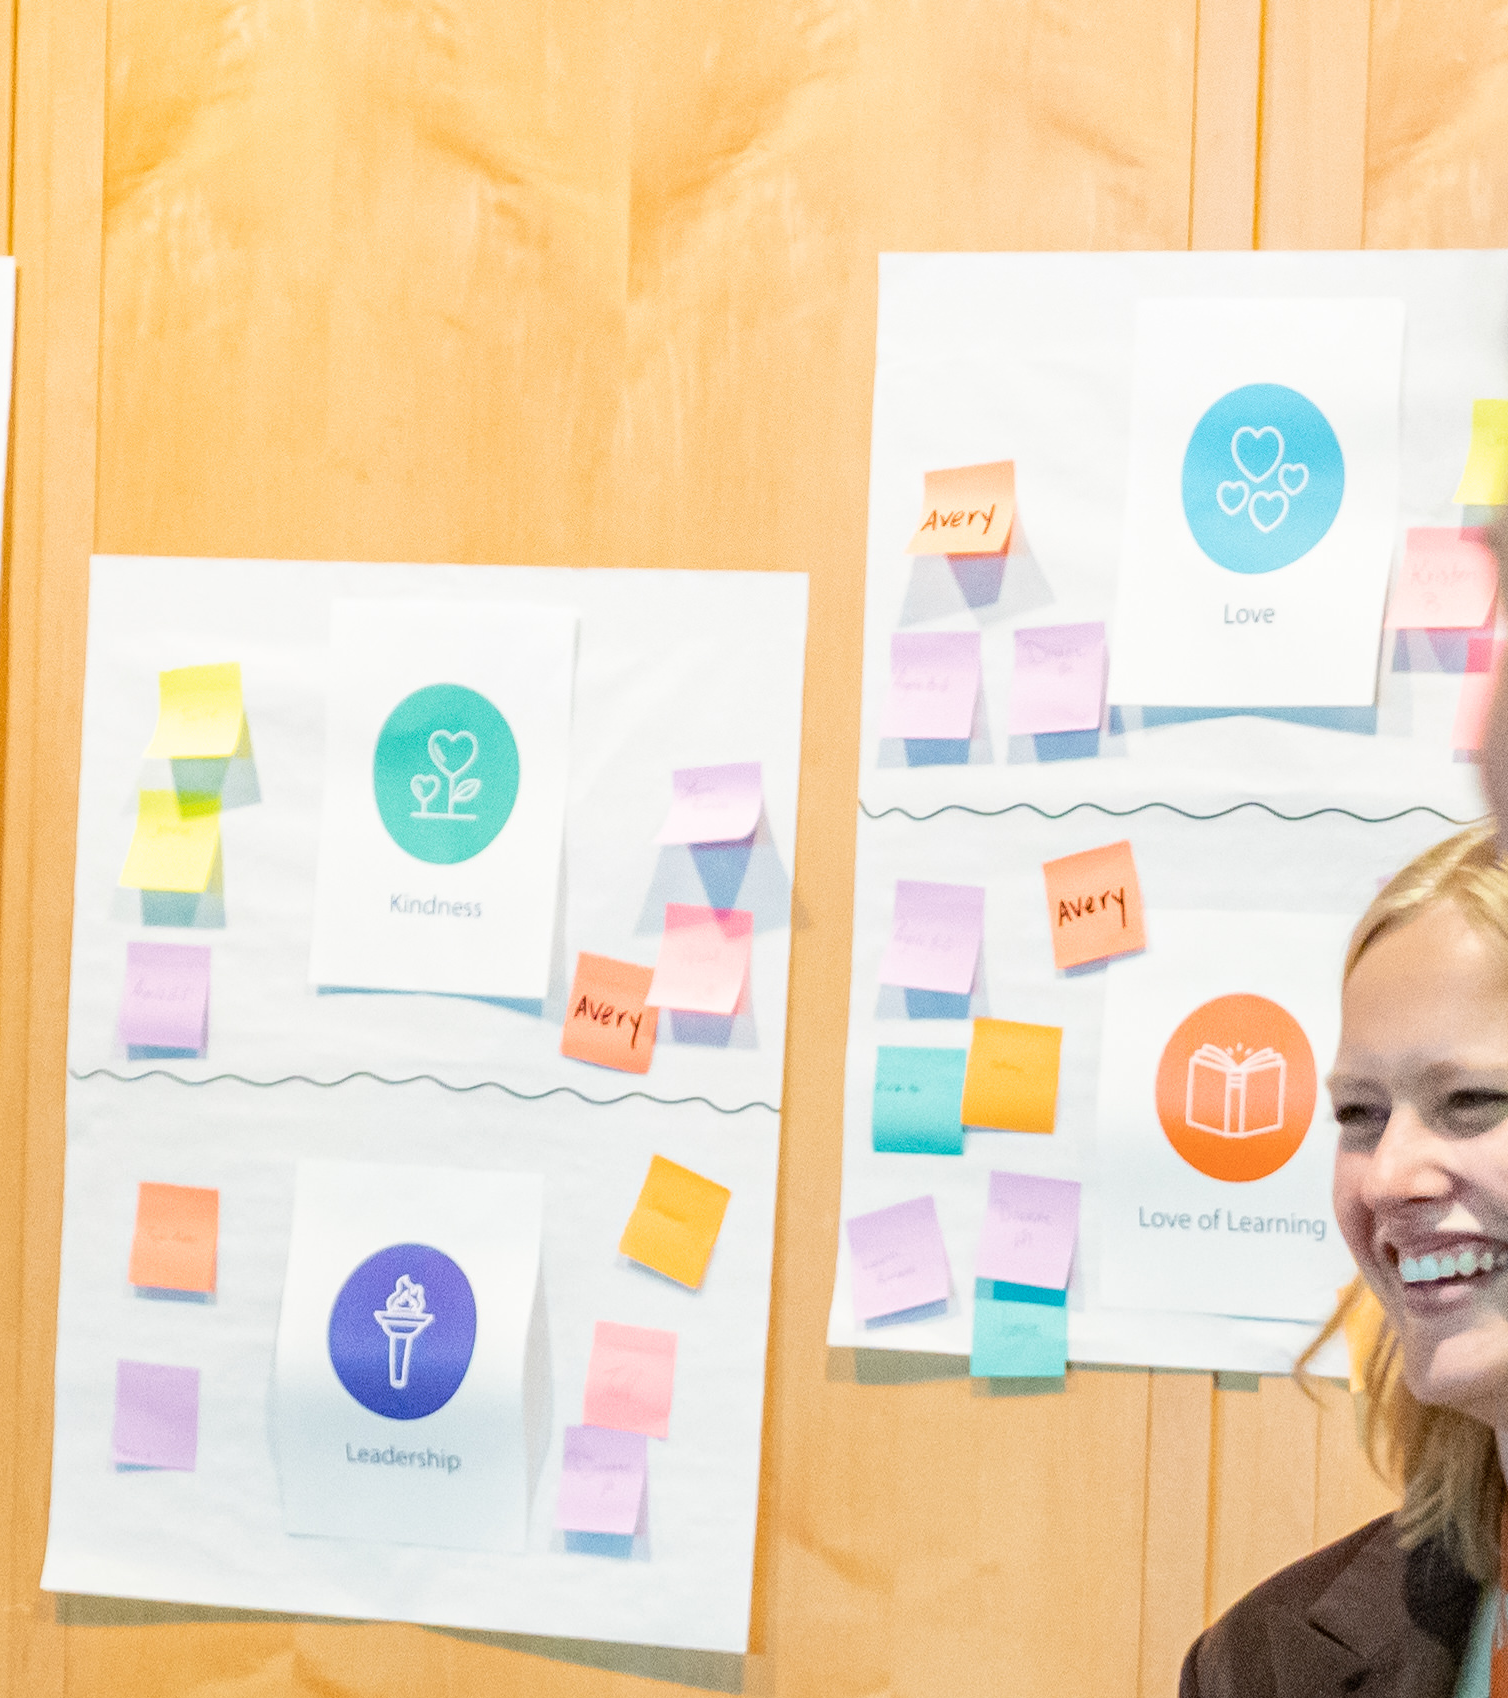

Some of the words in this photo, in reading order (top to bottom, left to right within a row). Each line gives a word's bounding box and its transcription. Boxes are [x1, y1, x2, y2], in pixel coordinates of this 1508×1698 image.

[920, 502, 997, 535] Avery
[1222, 603, 1277, 626] Love
[388, 892, 484, 919] Kindness
[1057, 885, 1128, 929] Avery
[573, 993, 644, 1050] Avery
[1137, 1205, 1189, 1231] Love
[1196, 1206, 1222, 1232] of
[1225, 1209, 1329, 1243] Learning
[344, 1441, 463, 1475] Leadership
